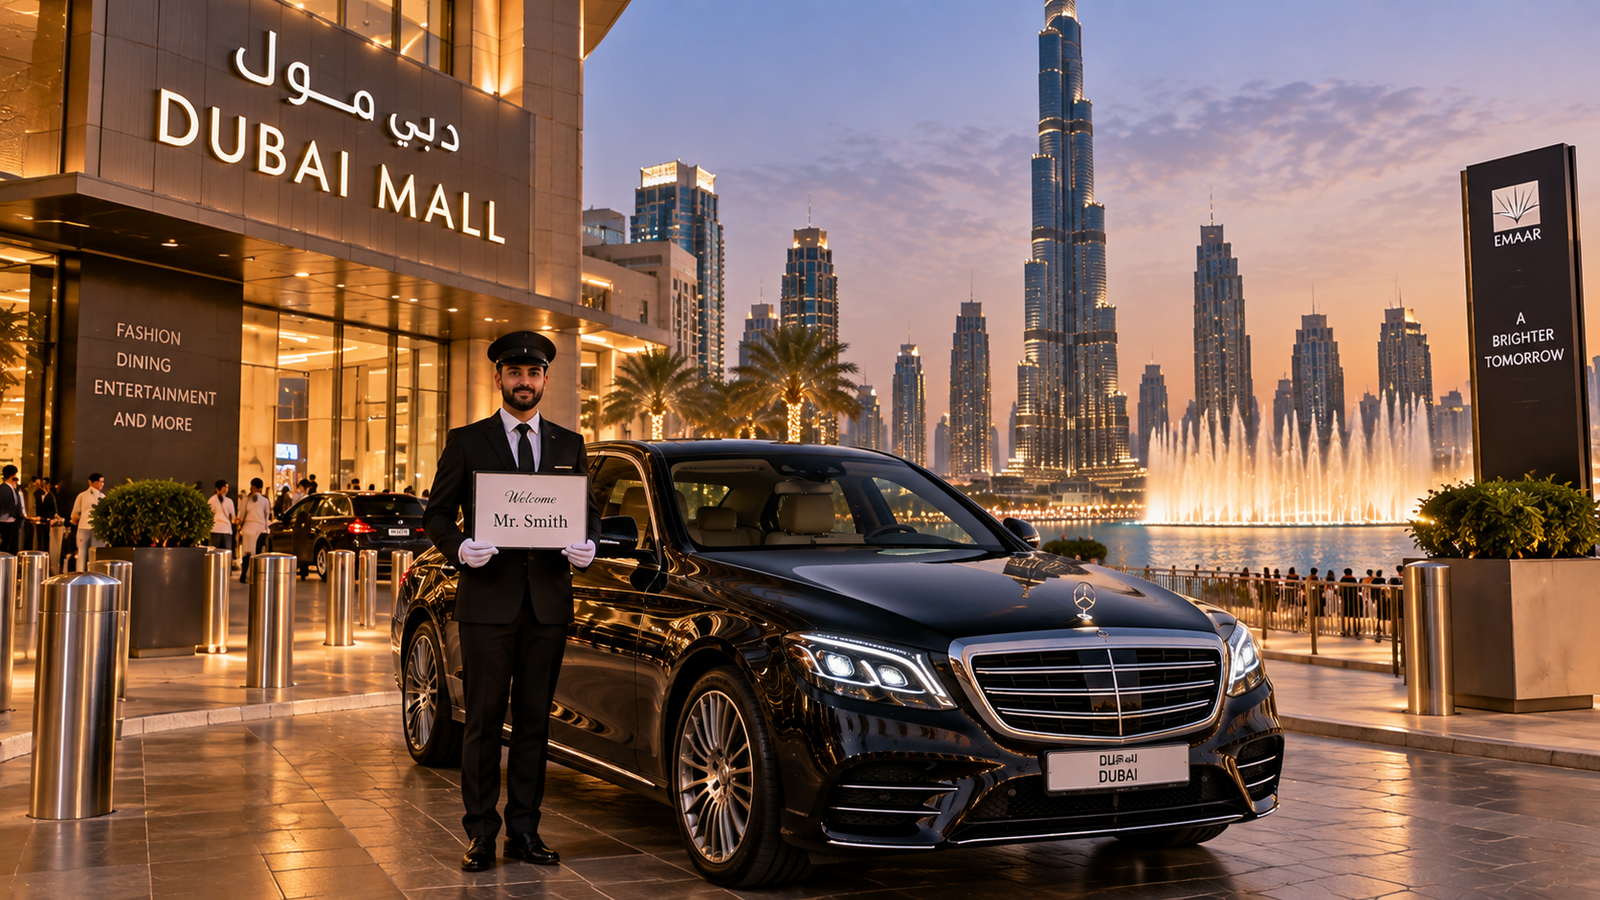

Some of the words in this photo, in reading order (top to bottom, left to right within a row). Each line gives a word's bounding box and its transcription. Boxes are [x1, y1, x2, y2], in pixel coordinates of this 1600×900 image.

[234, 30, 375, 121] مول
[389, 113, 460, 152] دبي
[157, 88, 349, 198] DUBAI
[378, 164, 506, 245] MALL
[1494, 228, 1542, 247] EMAAR
[1515, 311, 1527, 326] A
[116, 322, 181, 346] FASHION
[1492, 328, 1555, 348] BRIGHTER
[116, 352, 171, 373] DINING
[1484, 348, 1565, 368] TOMORROW
[94, 379, 217, 406] ENTERTAINMENT
[113, 411, 147, 428] AND
[151, 414, 193, 432] MORE
[505, 490, 557, 504] Welcome
[493, 513, 519, 528] Mr.
[524, 514, 568, 528] Smith
[1099, 768, 1138, 783] DUBAI
